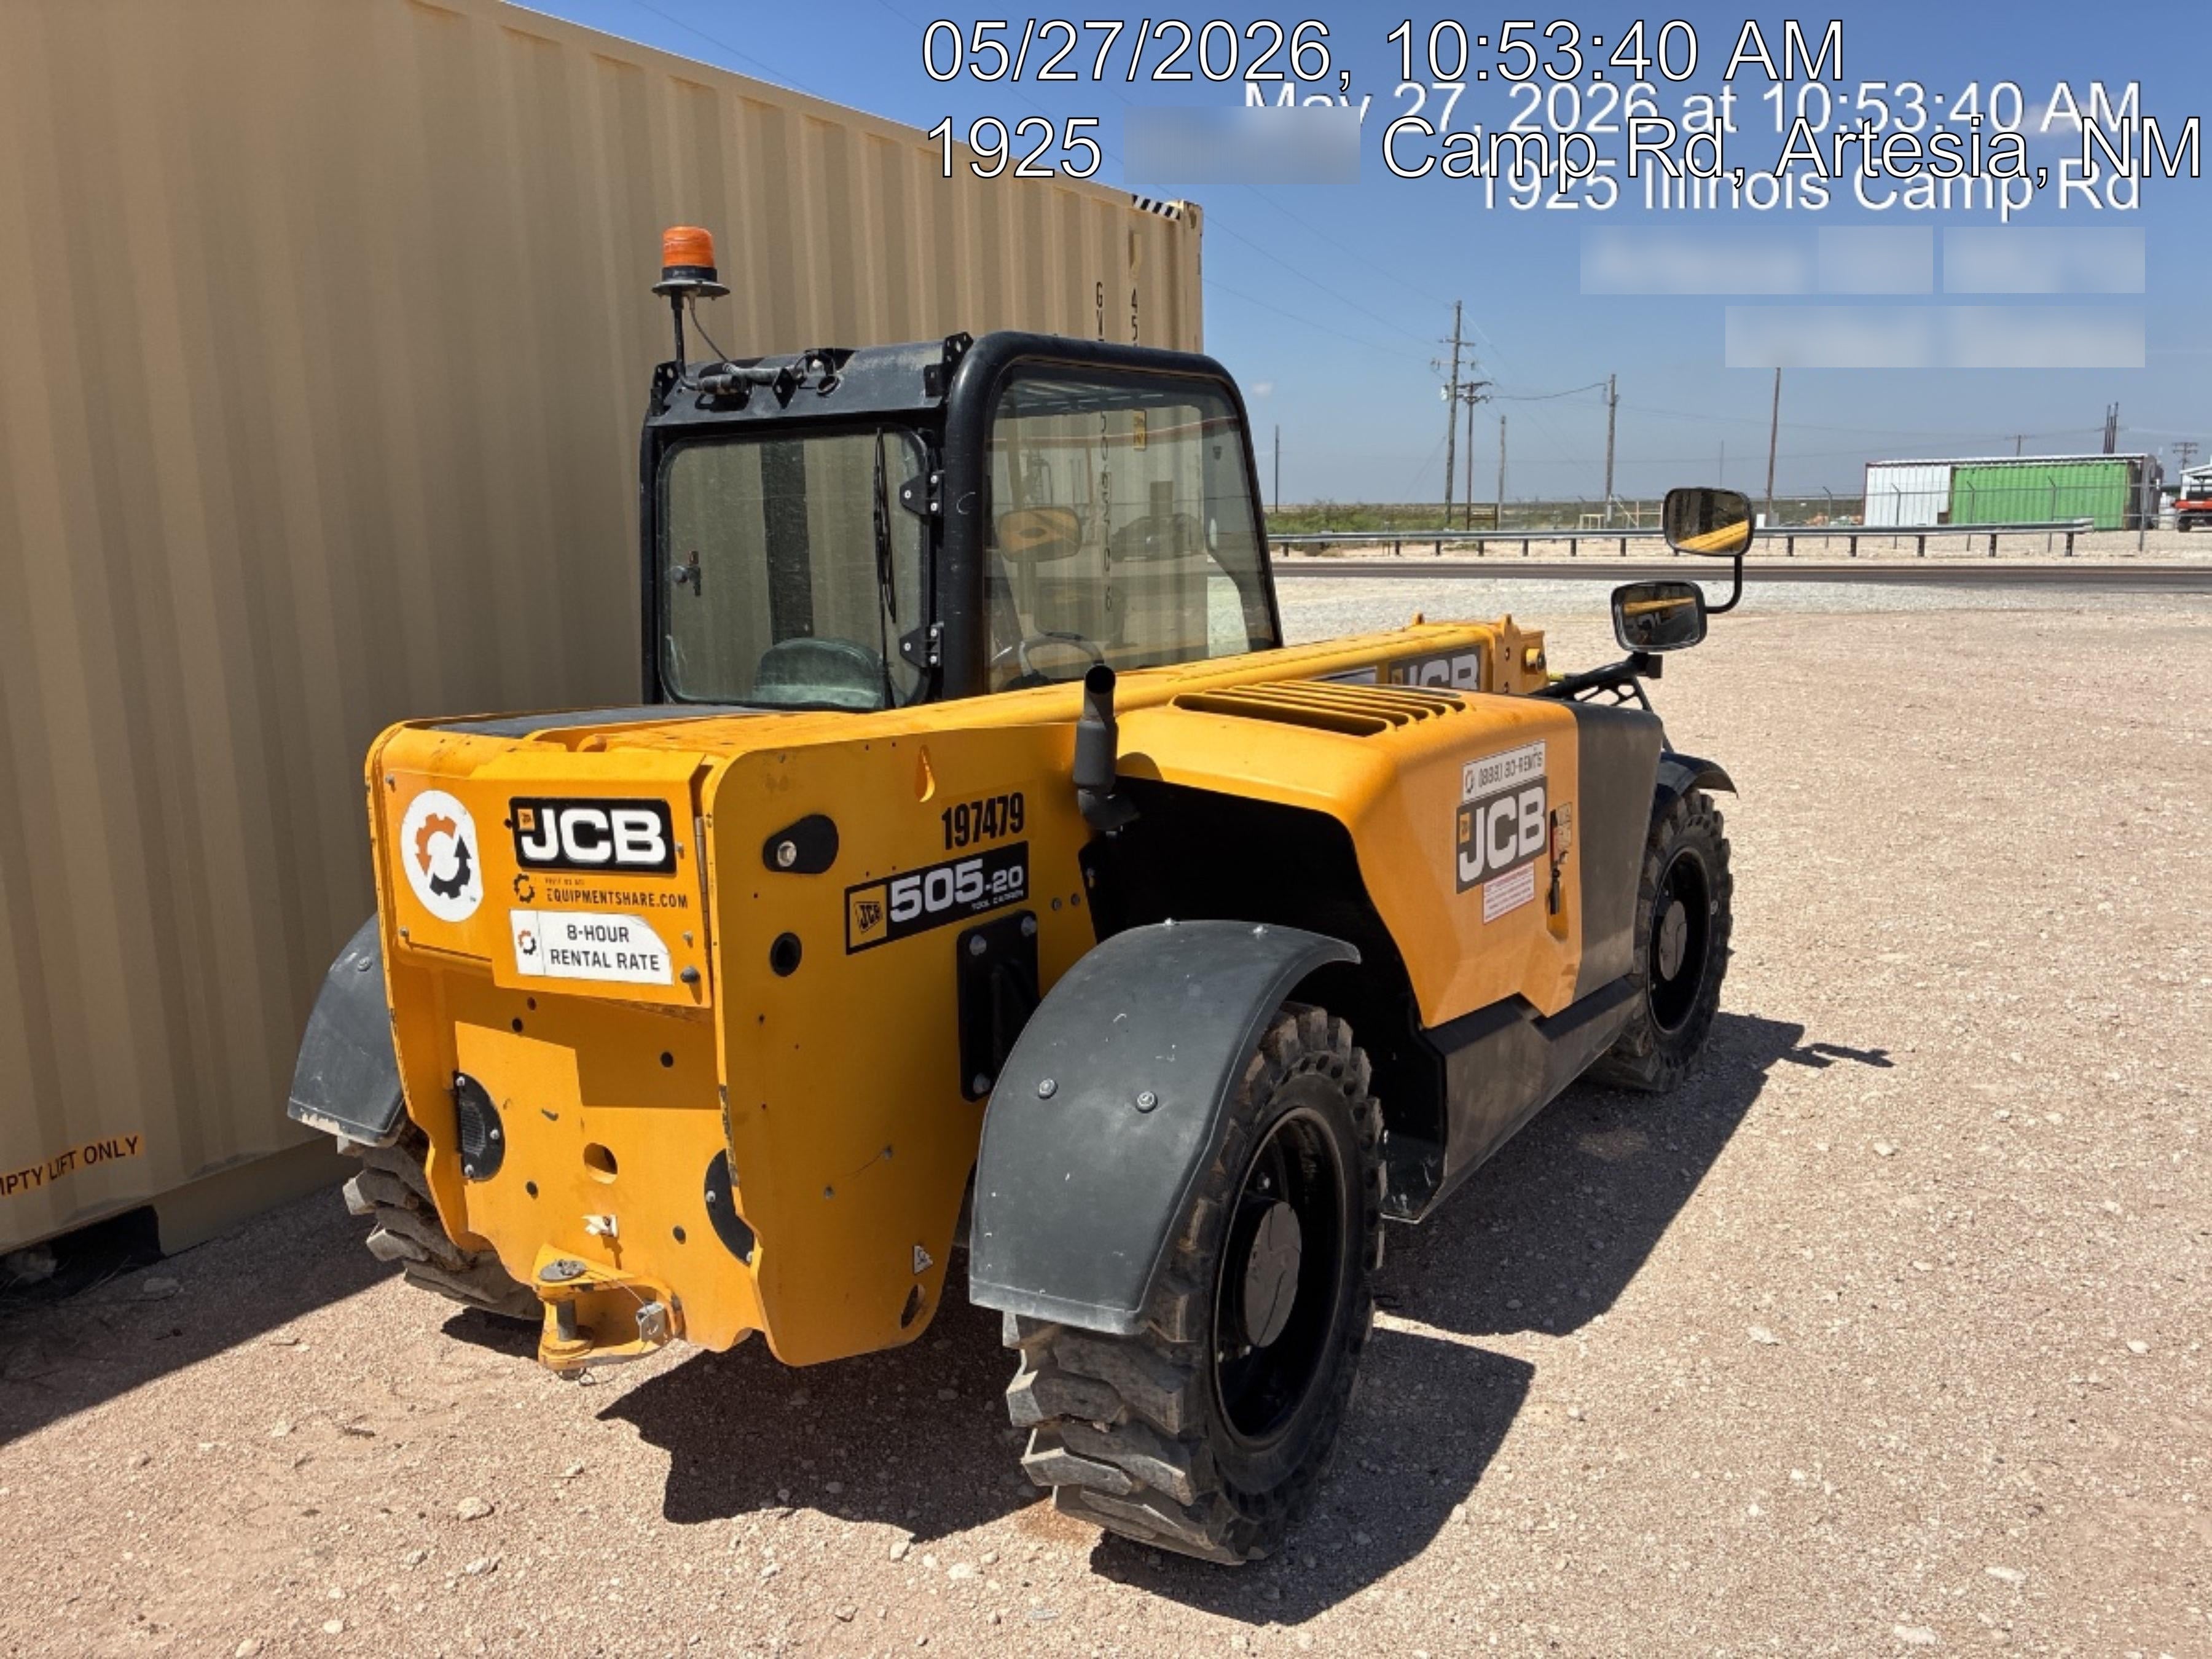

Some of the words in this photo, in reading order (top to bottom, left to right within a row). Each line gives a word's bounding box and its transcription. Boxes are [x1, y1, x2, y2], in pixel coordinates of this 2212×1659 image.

[521, 807, 667, 865] JCB
[941, 792, 1024, 850] 197479
[1459, 786, 1546, 882] JCB
[546, 888, 688, 909] EQUIPMENTSHARE.COM
[567, 925, 629, 943] 8-HOUR
[550, 948, 611, 968] RENTAL
[616, 952, 660, 971] RATE
[47, 1150, 77, 1180] LIFT
[84, 1135, 138, 1164] ONLY
